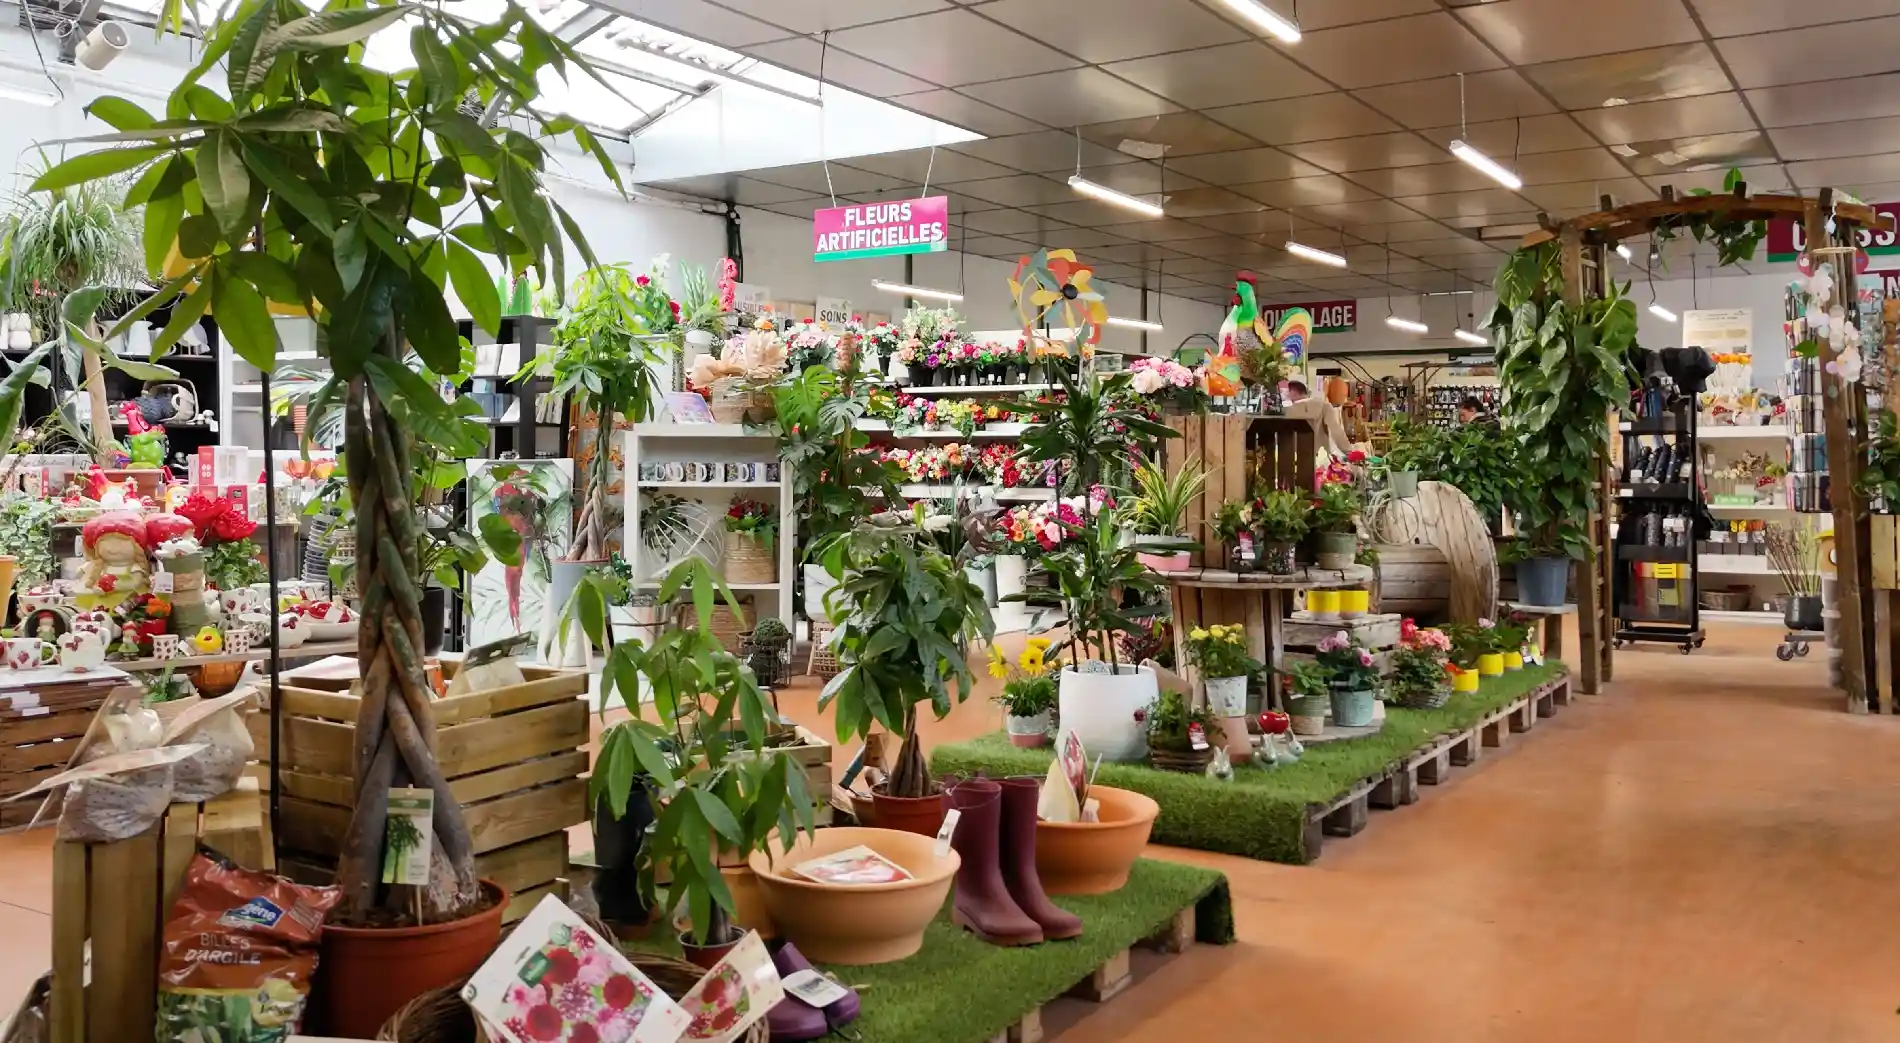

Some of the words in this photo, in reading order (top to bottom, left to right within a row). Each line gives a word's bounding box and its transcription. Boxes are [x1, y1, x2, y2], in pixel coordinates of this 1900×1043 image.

[844, 202, 912, 227] FLEURS
[816, 221, 944, 252] ARTIFICIELLES
[819, 308, 848, 325] SOINS
[1263, 305, 1354, 330] OULAGE
